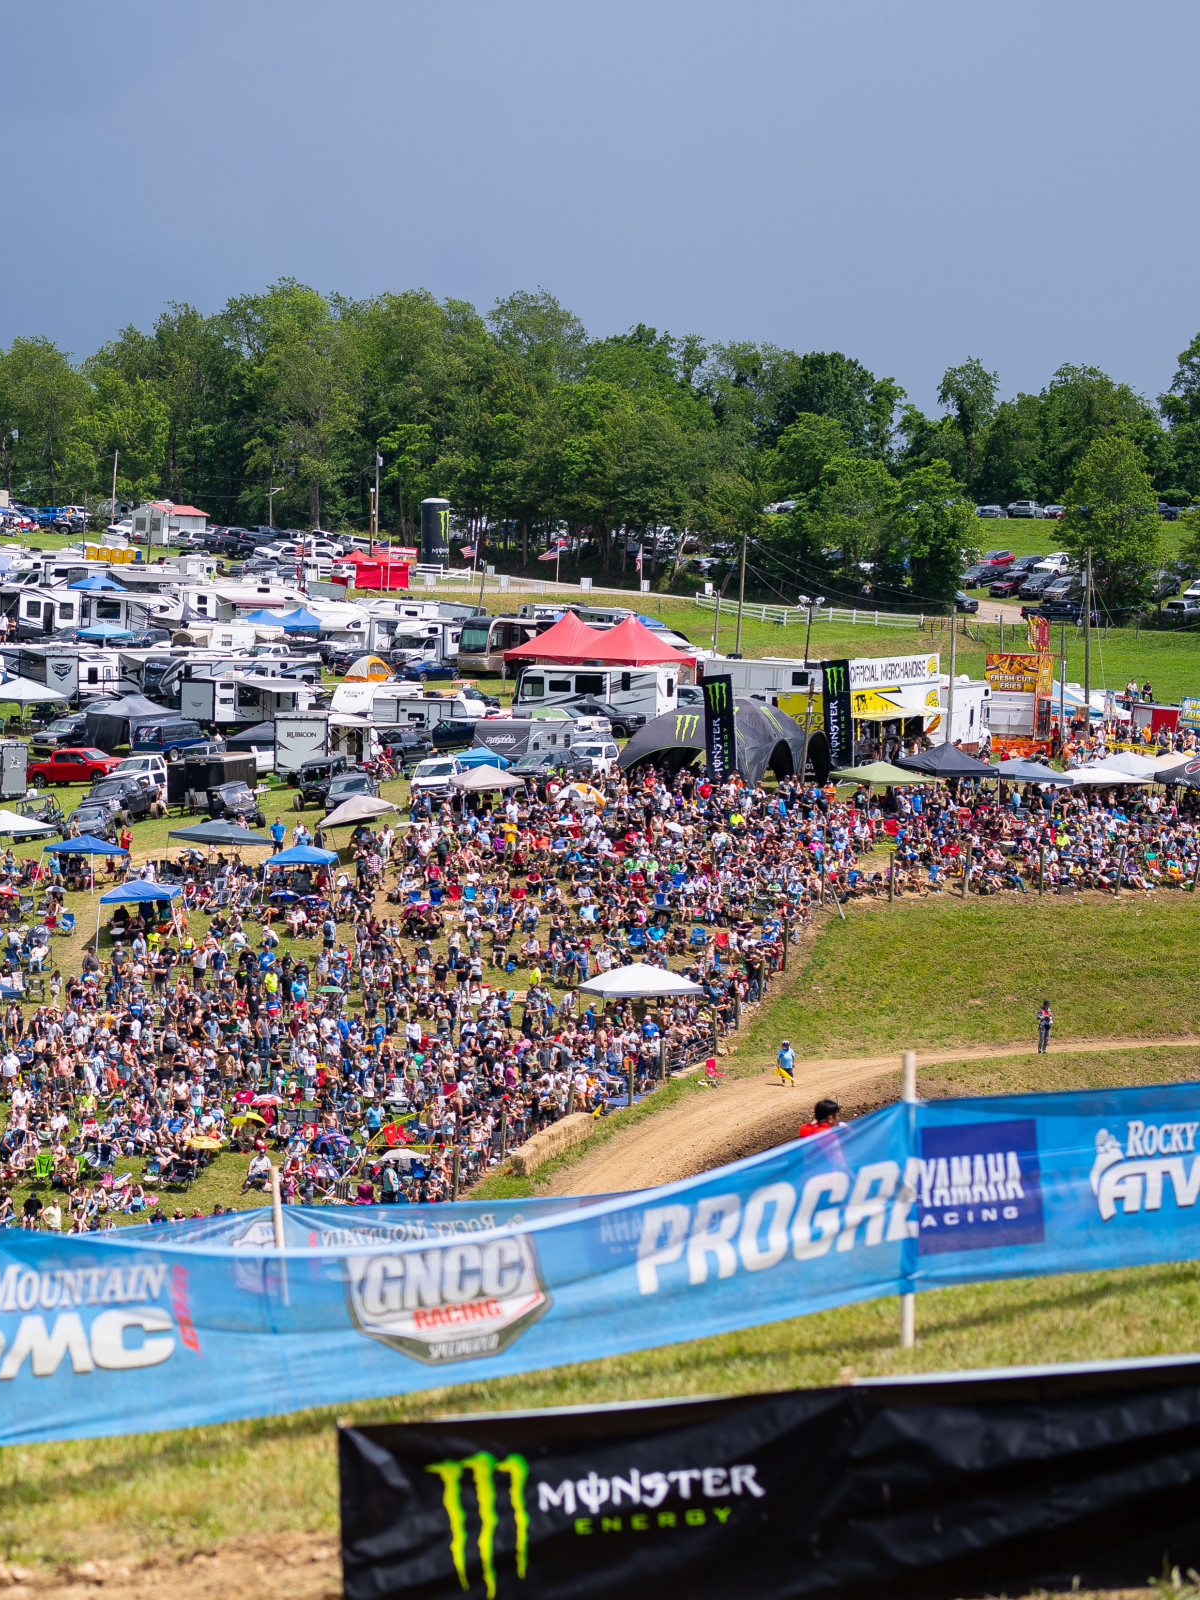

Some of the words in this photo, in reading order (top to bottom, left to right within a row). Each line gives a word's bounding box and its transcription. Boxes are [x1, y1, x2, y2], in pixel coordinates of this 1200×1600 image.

[849, 664, 879, 684] OFFICIAL
[880, 660, 926, 682] MERCHANDISE
[990, 674, 1015, 683] FRESH
[1016, 675, 1033, 683] CUT
[1000, 682, 1022, 691] FRIES
[286, 731, 317, 739] RUBICON
[828, 700, 839, 759] MONSTER
[1125, 1120, 1200, 1158] ROCKY
[919, 1151, 1025, 1208] YAMAHA
[920, 1205, 1019, 1229] ACING
[362, 1236, 525, 1316] GNCC
[412, 1297, 503, 1331] RACING
[537, 1463, 766, 1515] MONSTER
[573, 1506, 732, 1536] ENERGY
